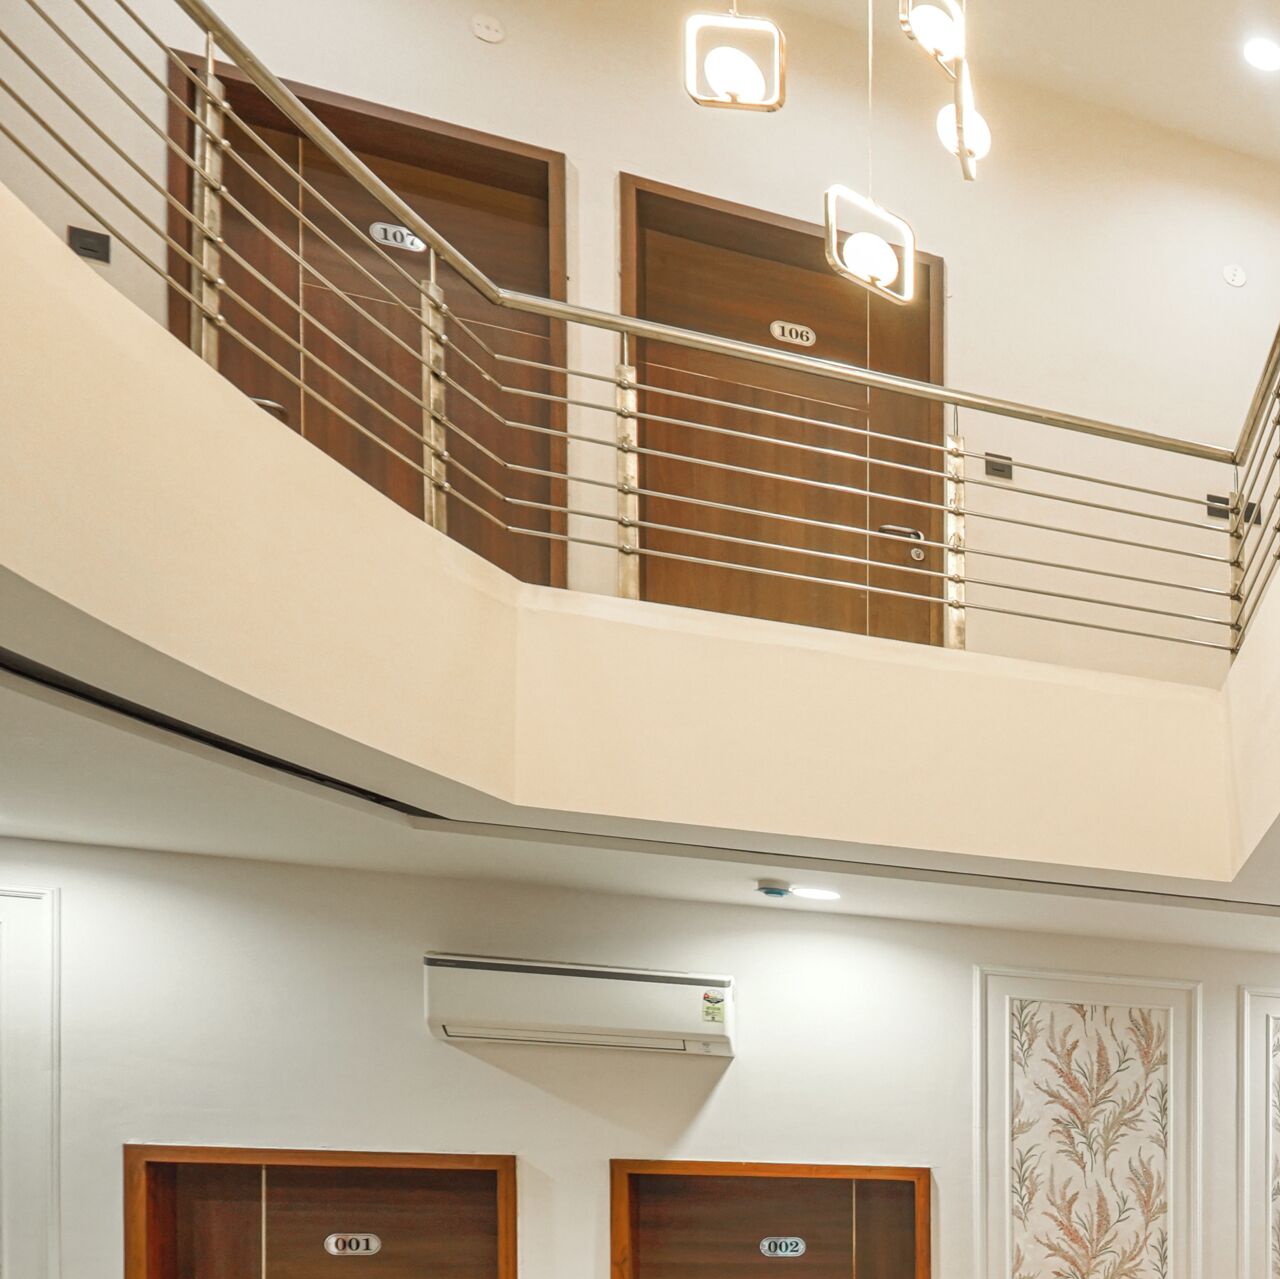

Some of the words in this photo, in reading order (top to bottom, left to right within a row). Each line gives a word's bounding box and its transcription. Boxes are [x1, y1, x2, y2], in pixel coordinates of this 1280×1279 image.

[380, 227, 416, 246] 107
[779, 325, 810, 342] 106
[335, 1237, 373, 1251] 001
[768, 1240, 799, 1253] 002
